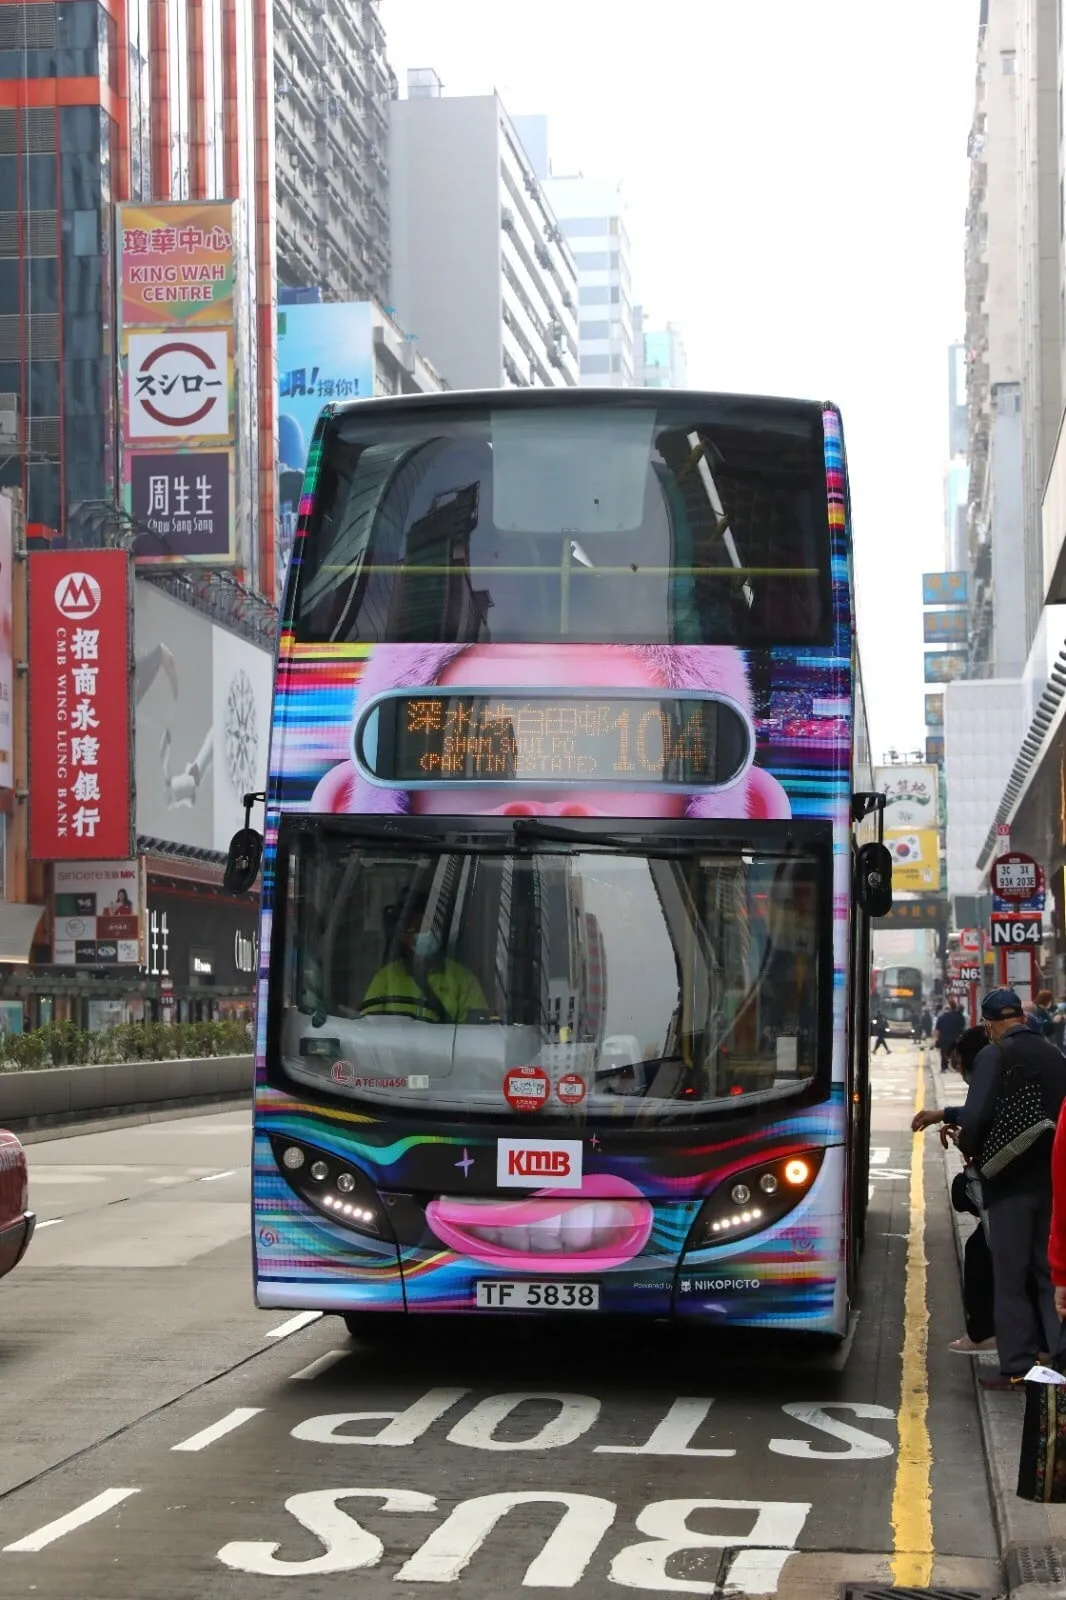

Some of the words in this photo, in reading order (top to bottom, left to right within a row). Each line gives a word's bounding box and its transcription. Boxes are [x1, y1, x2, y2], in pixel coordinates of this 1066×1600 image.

[123, 226, 232, 254] 瓊華中心
[130, 266, 176, 282] KING
[182, 264, 224, 281] WAH
[143, 285, 213, 302] CENTRE
[135, 374, 223, 397] スシロー
[147, 474, 213, 516] 周生生
[172, 517, 192, 534] Sang
[193, 517, 213, 533] Sang
[56, 627, 67, 666] CMB
[56, 673, 68, 722] WING
[70, 627, 101, 838] 招商永隆銀行
[444, 737, 493, 753] SHAM
[612, 707, 706, 774] 104
[57, 730, 68, 779] LUNG
[472, 754, 507, 771] TIN
[57, 787, 68, 838] BANK
[993, 922, 1041, 943] N64
[355, 1078, 406, 1088] ATENU450
[508, 1150, 571, 1176] KMB
[482, 1284, 515, 1305] TF
[525, 1285, 595, 1307] 5838
[694, 1278, 761, 1291] NIKOPICTO
[290, 1387, 898, 1461] STOP
[216, 1487, 812, 1596] BUS
